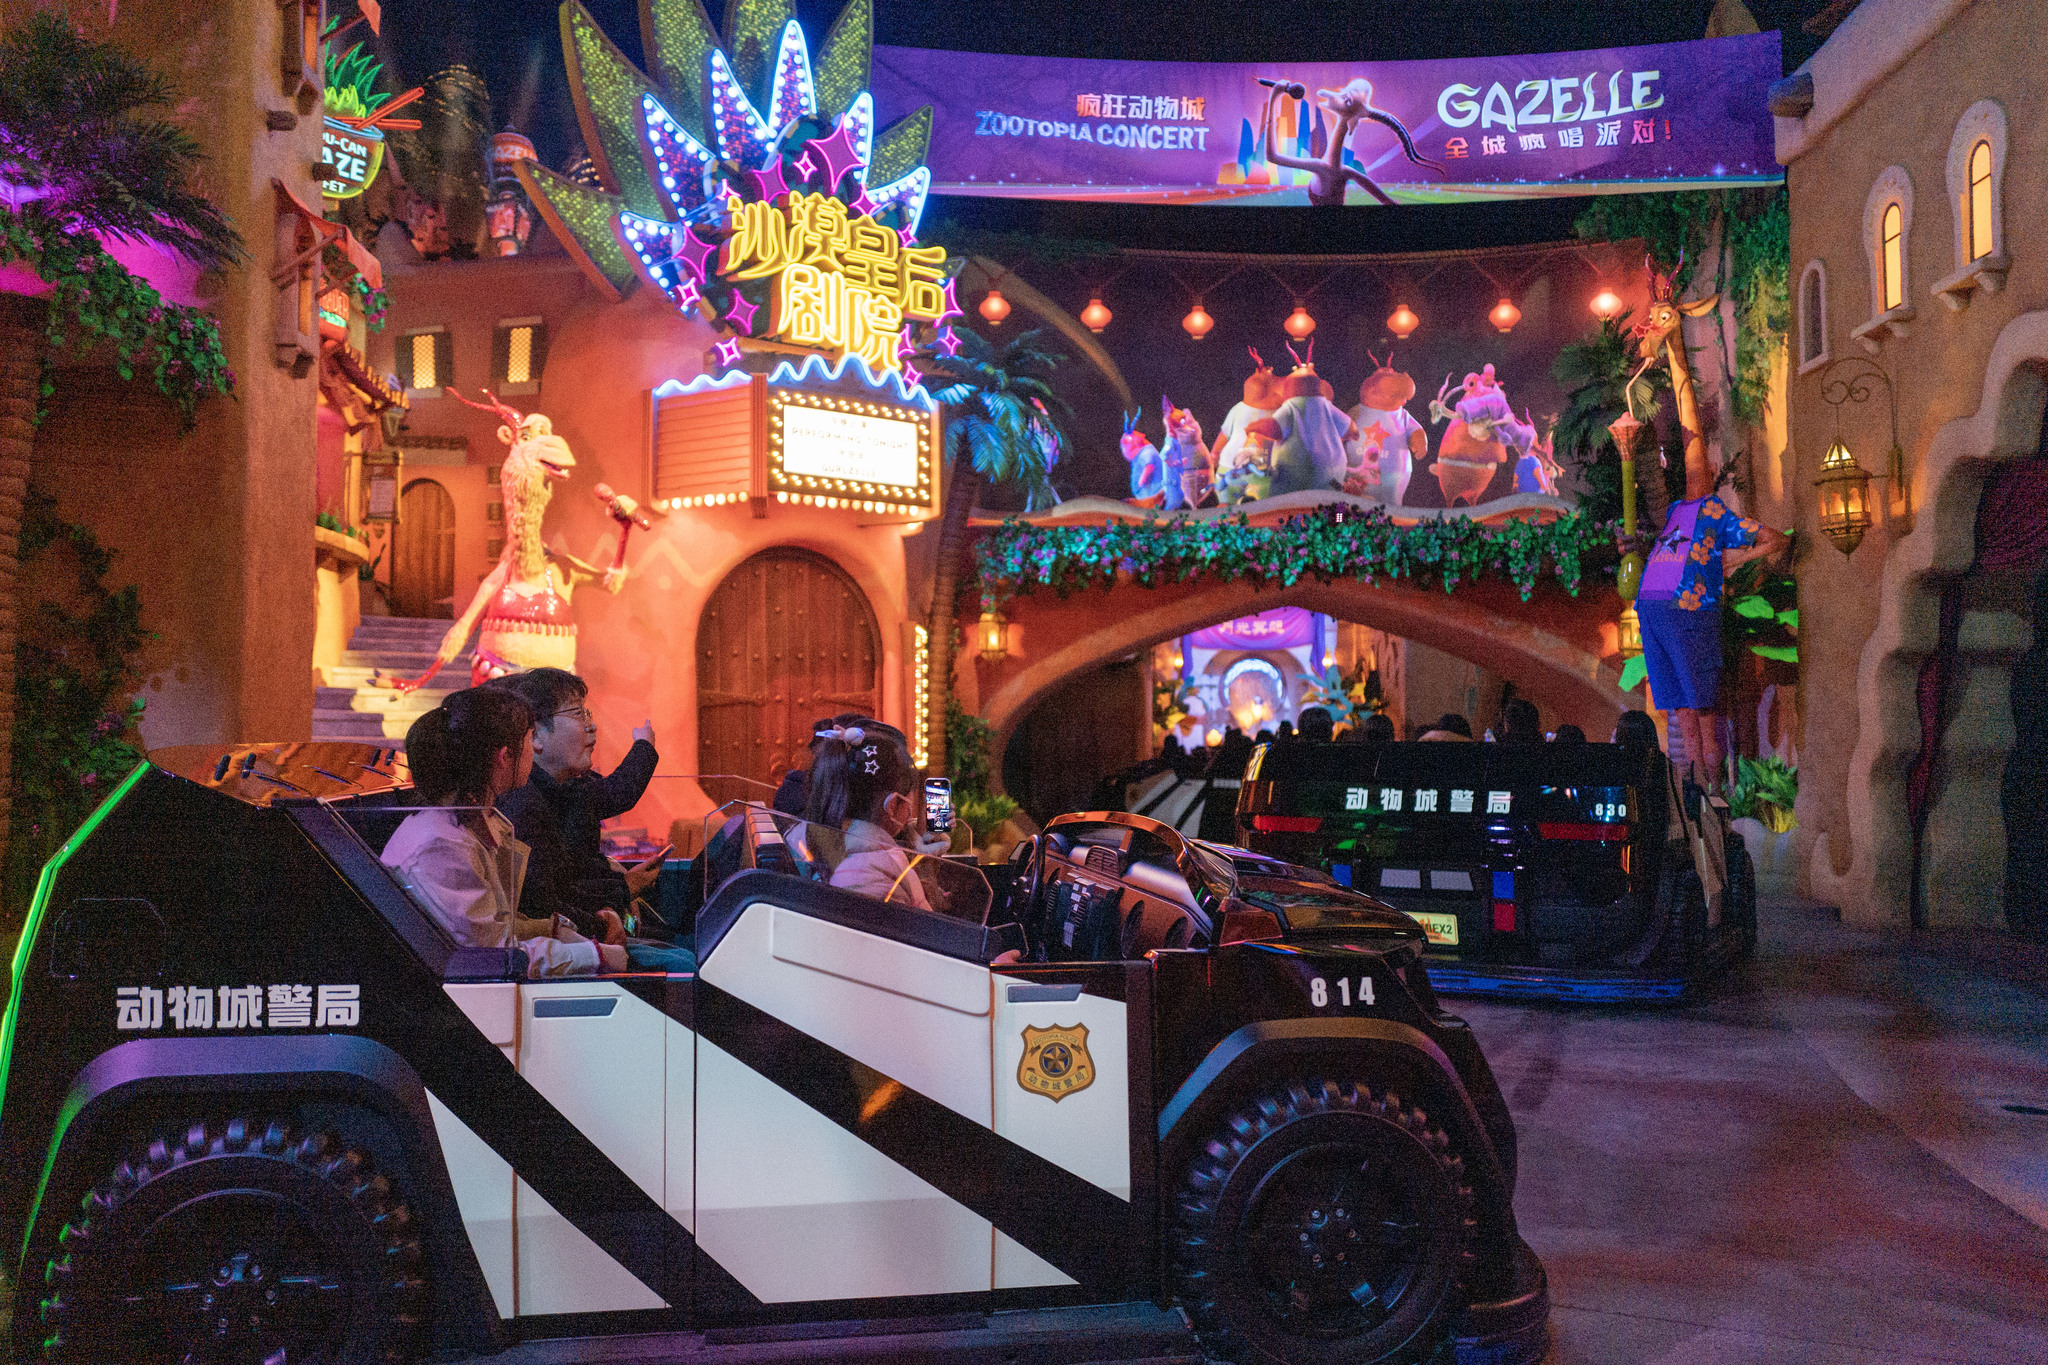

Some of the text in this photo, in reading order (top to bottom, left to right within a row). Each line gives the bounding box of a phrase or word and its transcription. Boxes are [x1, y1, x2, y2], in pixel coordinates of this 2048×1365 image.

[1076, 93, 1207, 121] 疯狂动物城
[1436, 69, 1665, 133] GAZELLE
[322, 132, 367, 158] U-CAN
[974, 110, 1210, 151] ZOOTOPIA CONCERT
[725, 190, 947, 319] 沙漠皇后
[777, 263, 903, 371] 剧院
[1345, 787, 1512, 814] 动物城警局
[1595, 803, 1627, 817] 830
[116, 983, 361, 1030] 动物城警局
[1310, 976, 1376, 1008] 814
[1028, 1072, 1085, 1091] 动物城警局
